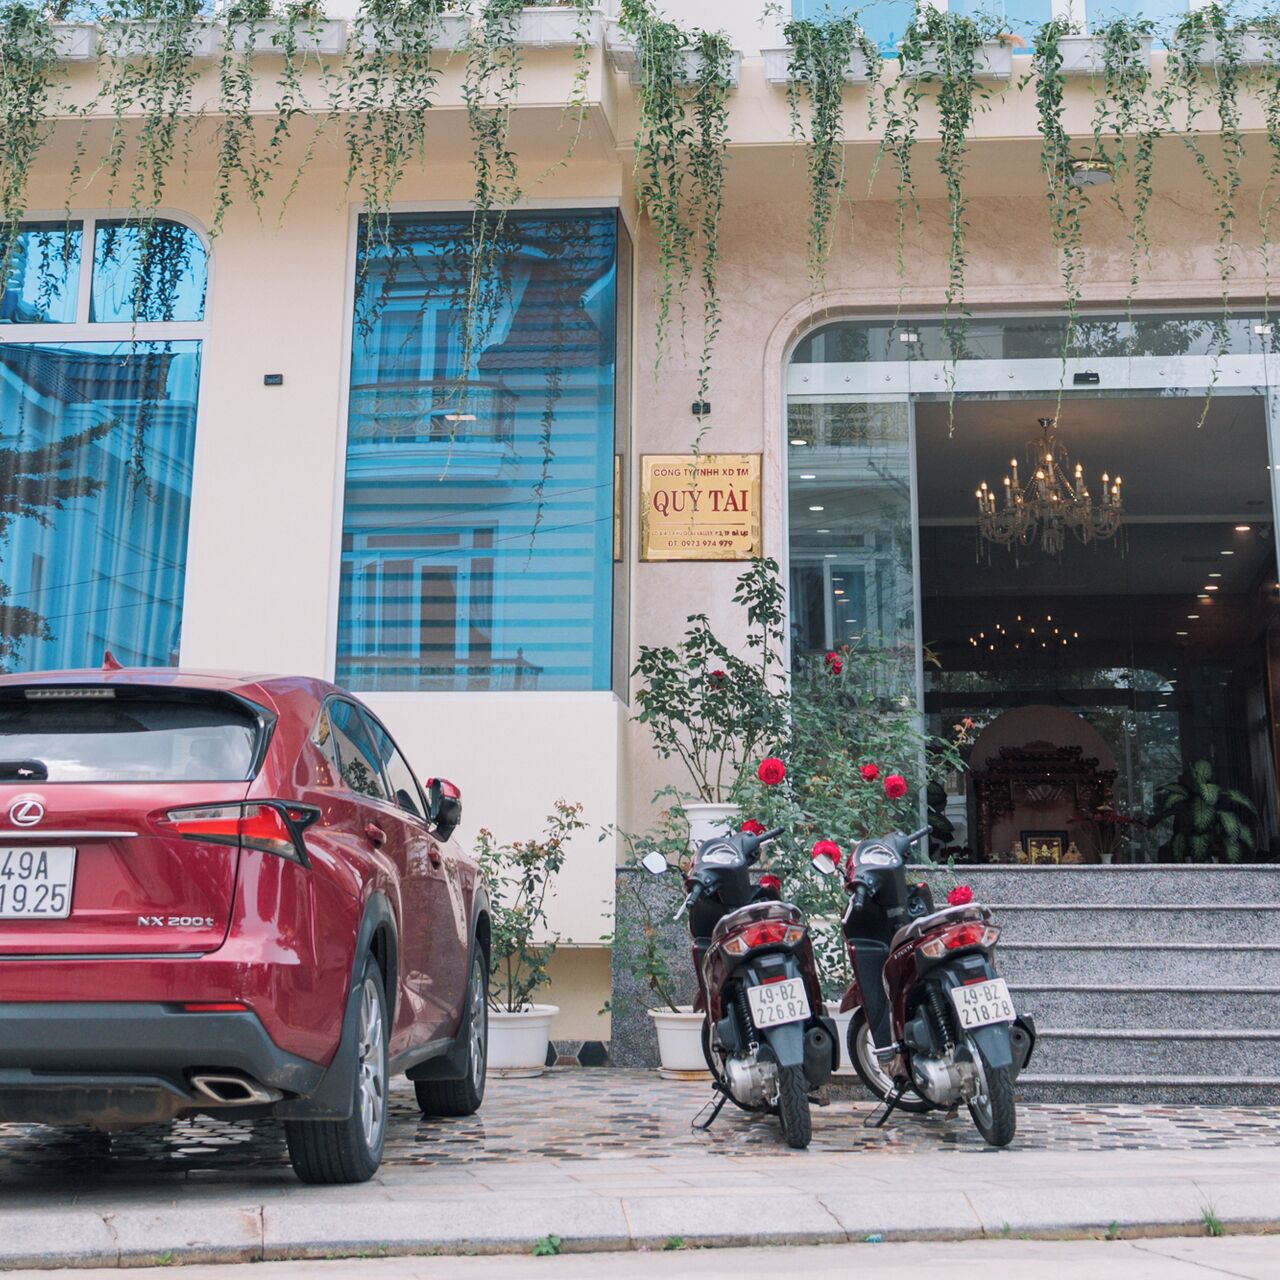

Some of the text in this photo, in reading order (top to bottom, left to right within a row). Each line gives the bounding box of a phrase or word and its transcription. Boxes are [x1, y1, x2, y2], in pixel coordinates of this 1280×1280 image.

[696, 468, 720, 477] TNHH
[722, 468, 734, 477] XD
[736, 468, 749, 477] TM
[653, 483, 749, 517] QUÝ TÀI
[1, 851, 48, 880] 49A
[137, 916, 214, 927] NX 200t
[760, 983, 797, 1005] 49-B2
[963, 984, 1001, 1006] 49-B2
[757, 999, 807, 1024] 226.82
[961, 1000, 1011, 1025] 218.28
